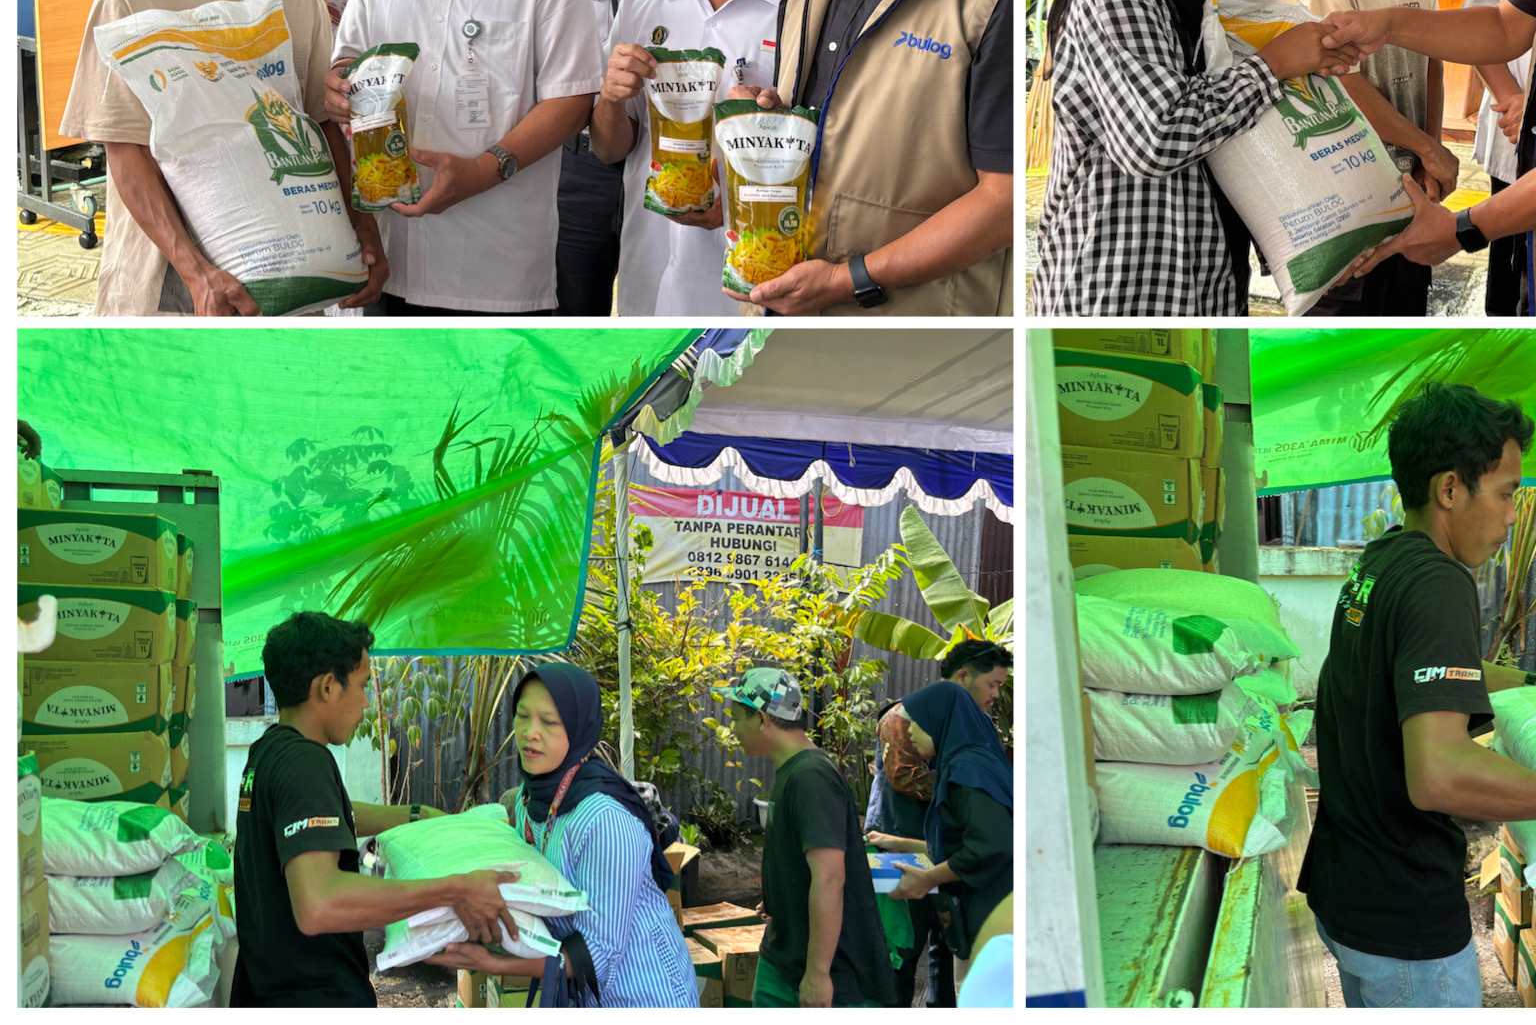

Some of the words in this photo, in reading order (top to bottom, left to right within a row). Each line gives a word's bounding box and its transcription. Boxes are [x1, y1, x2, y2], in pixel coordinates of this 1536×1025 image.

[907, 32, 951, 59] bulog
[1310, 142, 1344, 161] BERAS
[1345, 128, 1369, 146] MEDIUM
[1343, 155, 1360, 170] 10
[1362, 149, 1377, 163] kg
[283, 184, 317, 196] BERAS
[313, 201, 327, 214] 10
[329, 200, 341, 215] kg
[1282, 211, 1313, 229] Perum
[1314, 199, 1345, 216] BULOG
[697, 494, 791, 520] DIJUAL
[674, 521, 722, 533] TANPA
[727, 522, 802, 538] PERANTAR
[688, 551, 725, 563] 0812
[727, 552, 760, 565] 9867
[1413, 666, 1446, 683] CJM
[1449, 670, 1481, 679] TRANS
[1168, 784, 1210, 828] bulog
[310, 818, 339, 827] TRANS
[105, 950, 142, 988] bulog
